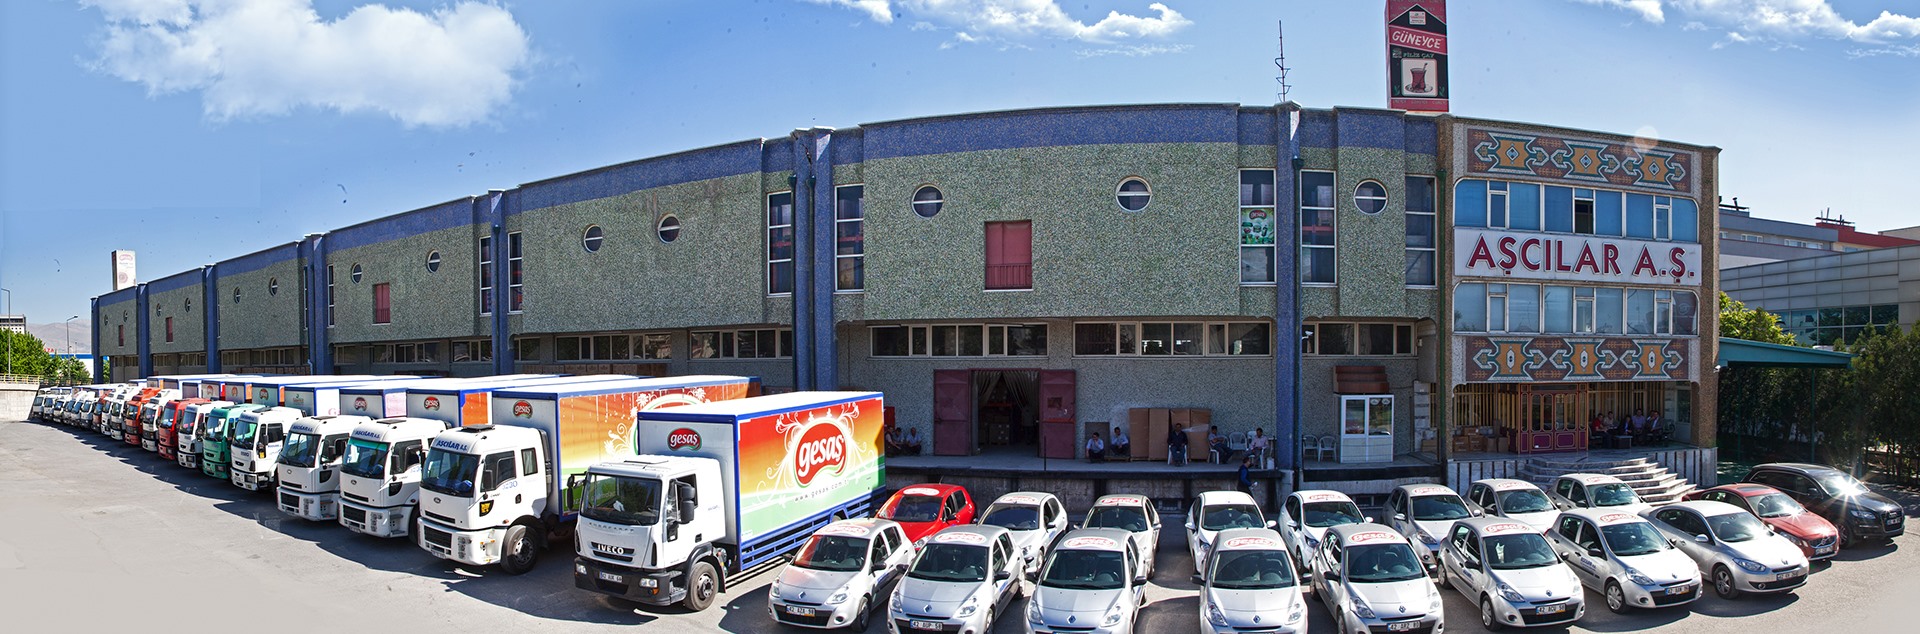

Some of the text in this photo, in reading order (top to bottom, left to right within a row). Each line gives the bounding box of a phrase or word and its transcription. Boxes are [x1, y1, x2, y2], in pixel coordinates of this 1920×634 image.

[1392, 30, 1441, 49] GÜNEYCE
[1466, 233, 1696, 284] AŞCILAR A.Ş.
[670, 432, 698, 449] gesaş
[798, 434, 844, 477] gesaş
[597, 544, 624, 555] IVECO
